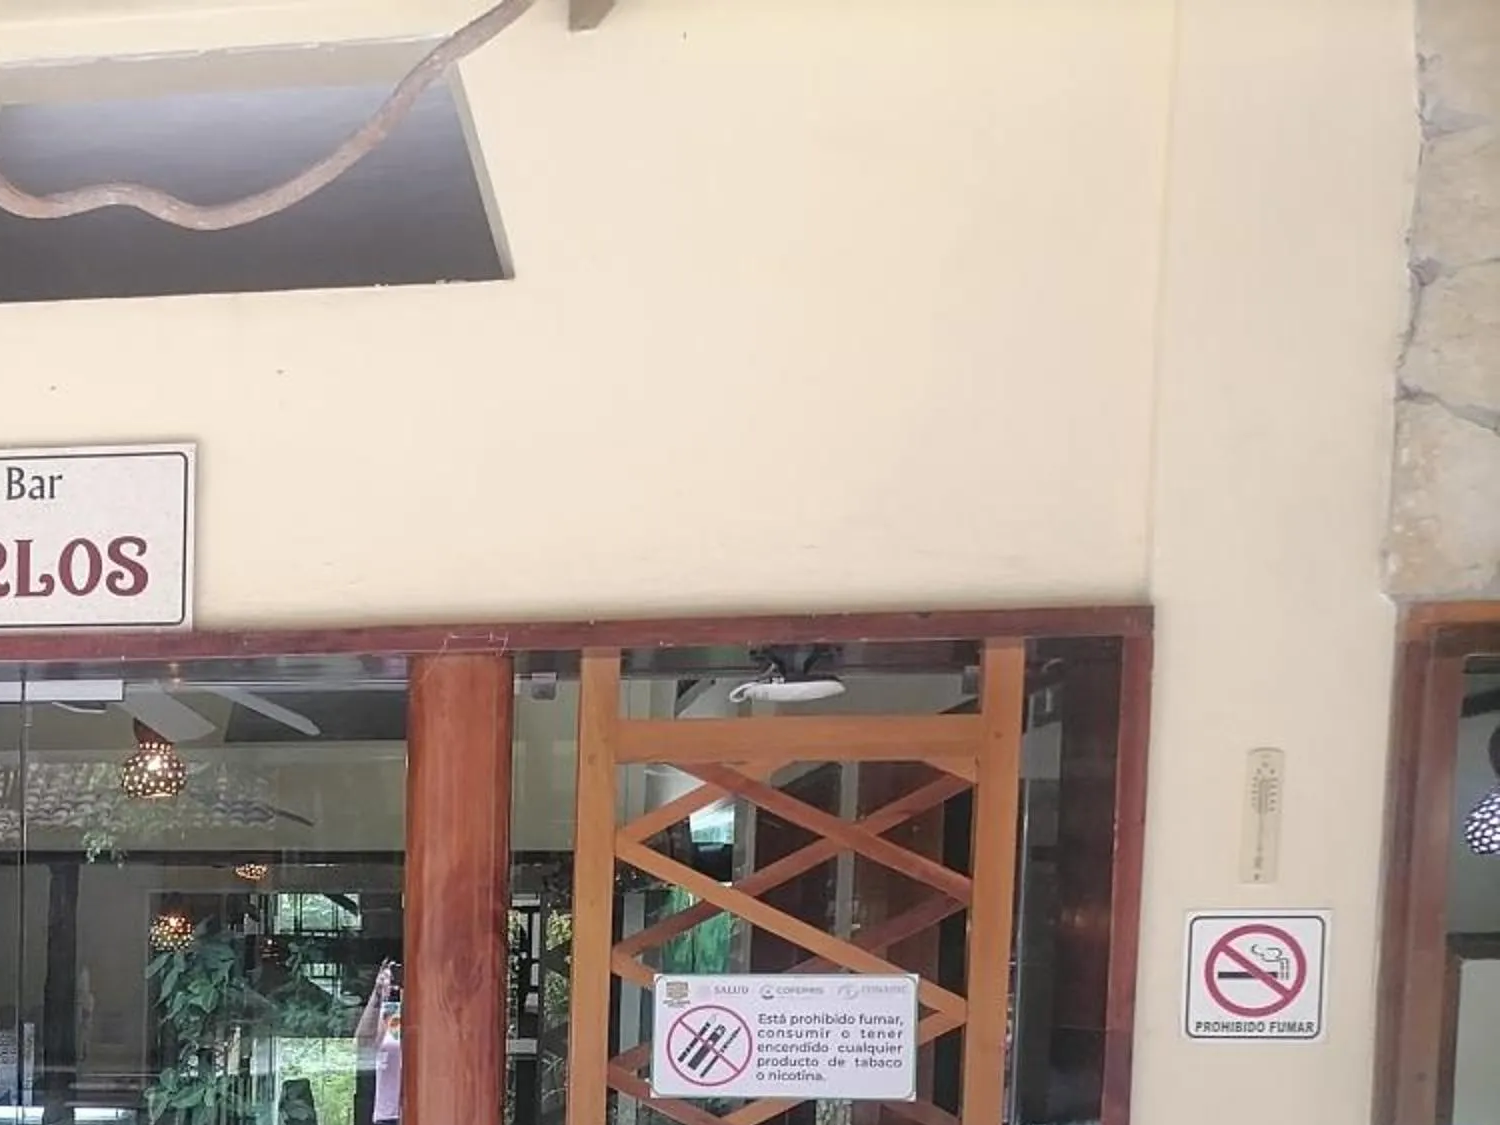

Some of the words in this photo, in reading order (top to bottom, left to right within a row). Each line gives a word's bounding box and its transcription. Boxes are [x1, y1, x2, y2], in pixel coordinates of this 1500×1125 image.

[713, 985, 749, 995] SALUD
[757, 1013, 787, 1025] Está
[790, 1013, 856, 1027] prohibido
[859, 1013, 904, 1027] fumar,
[757, 1027, 831, 1039] consumir
[841, 1029, 850, 1039] o
[860, 1029, 903, 1039] tener
[1195, 1021, 1266, 1033] PROHIBIDO
[1269, 1021, 1315, 1033] FUMAR
[757, 1042, 830, 1053] encendido
[837, 1042, 903, 1056] cualquier
[756, 1057, 819, 1070] producto
[828, 1057, 845, 1068] de
[854, 1057, 903, 1069] tabaco
[756, 1072, 765, 1081] o
[768, 1069, 826, 1082] nicotina.
